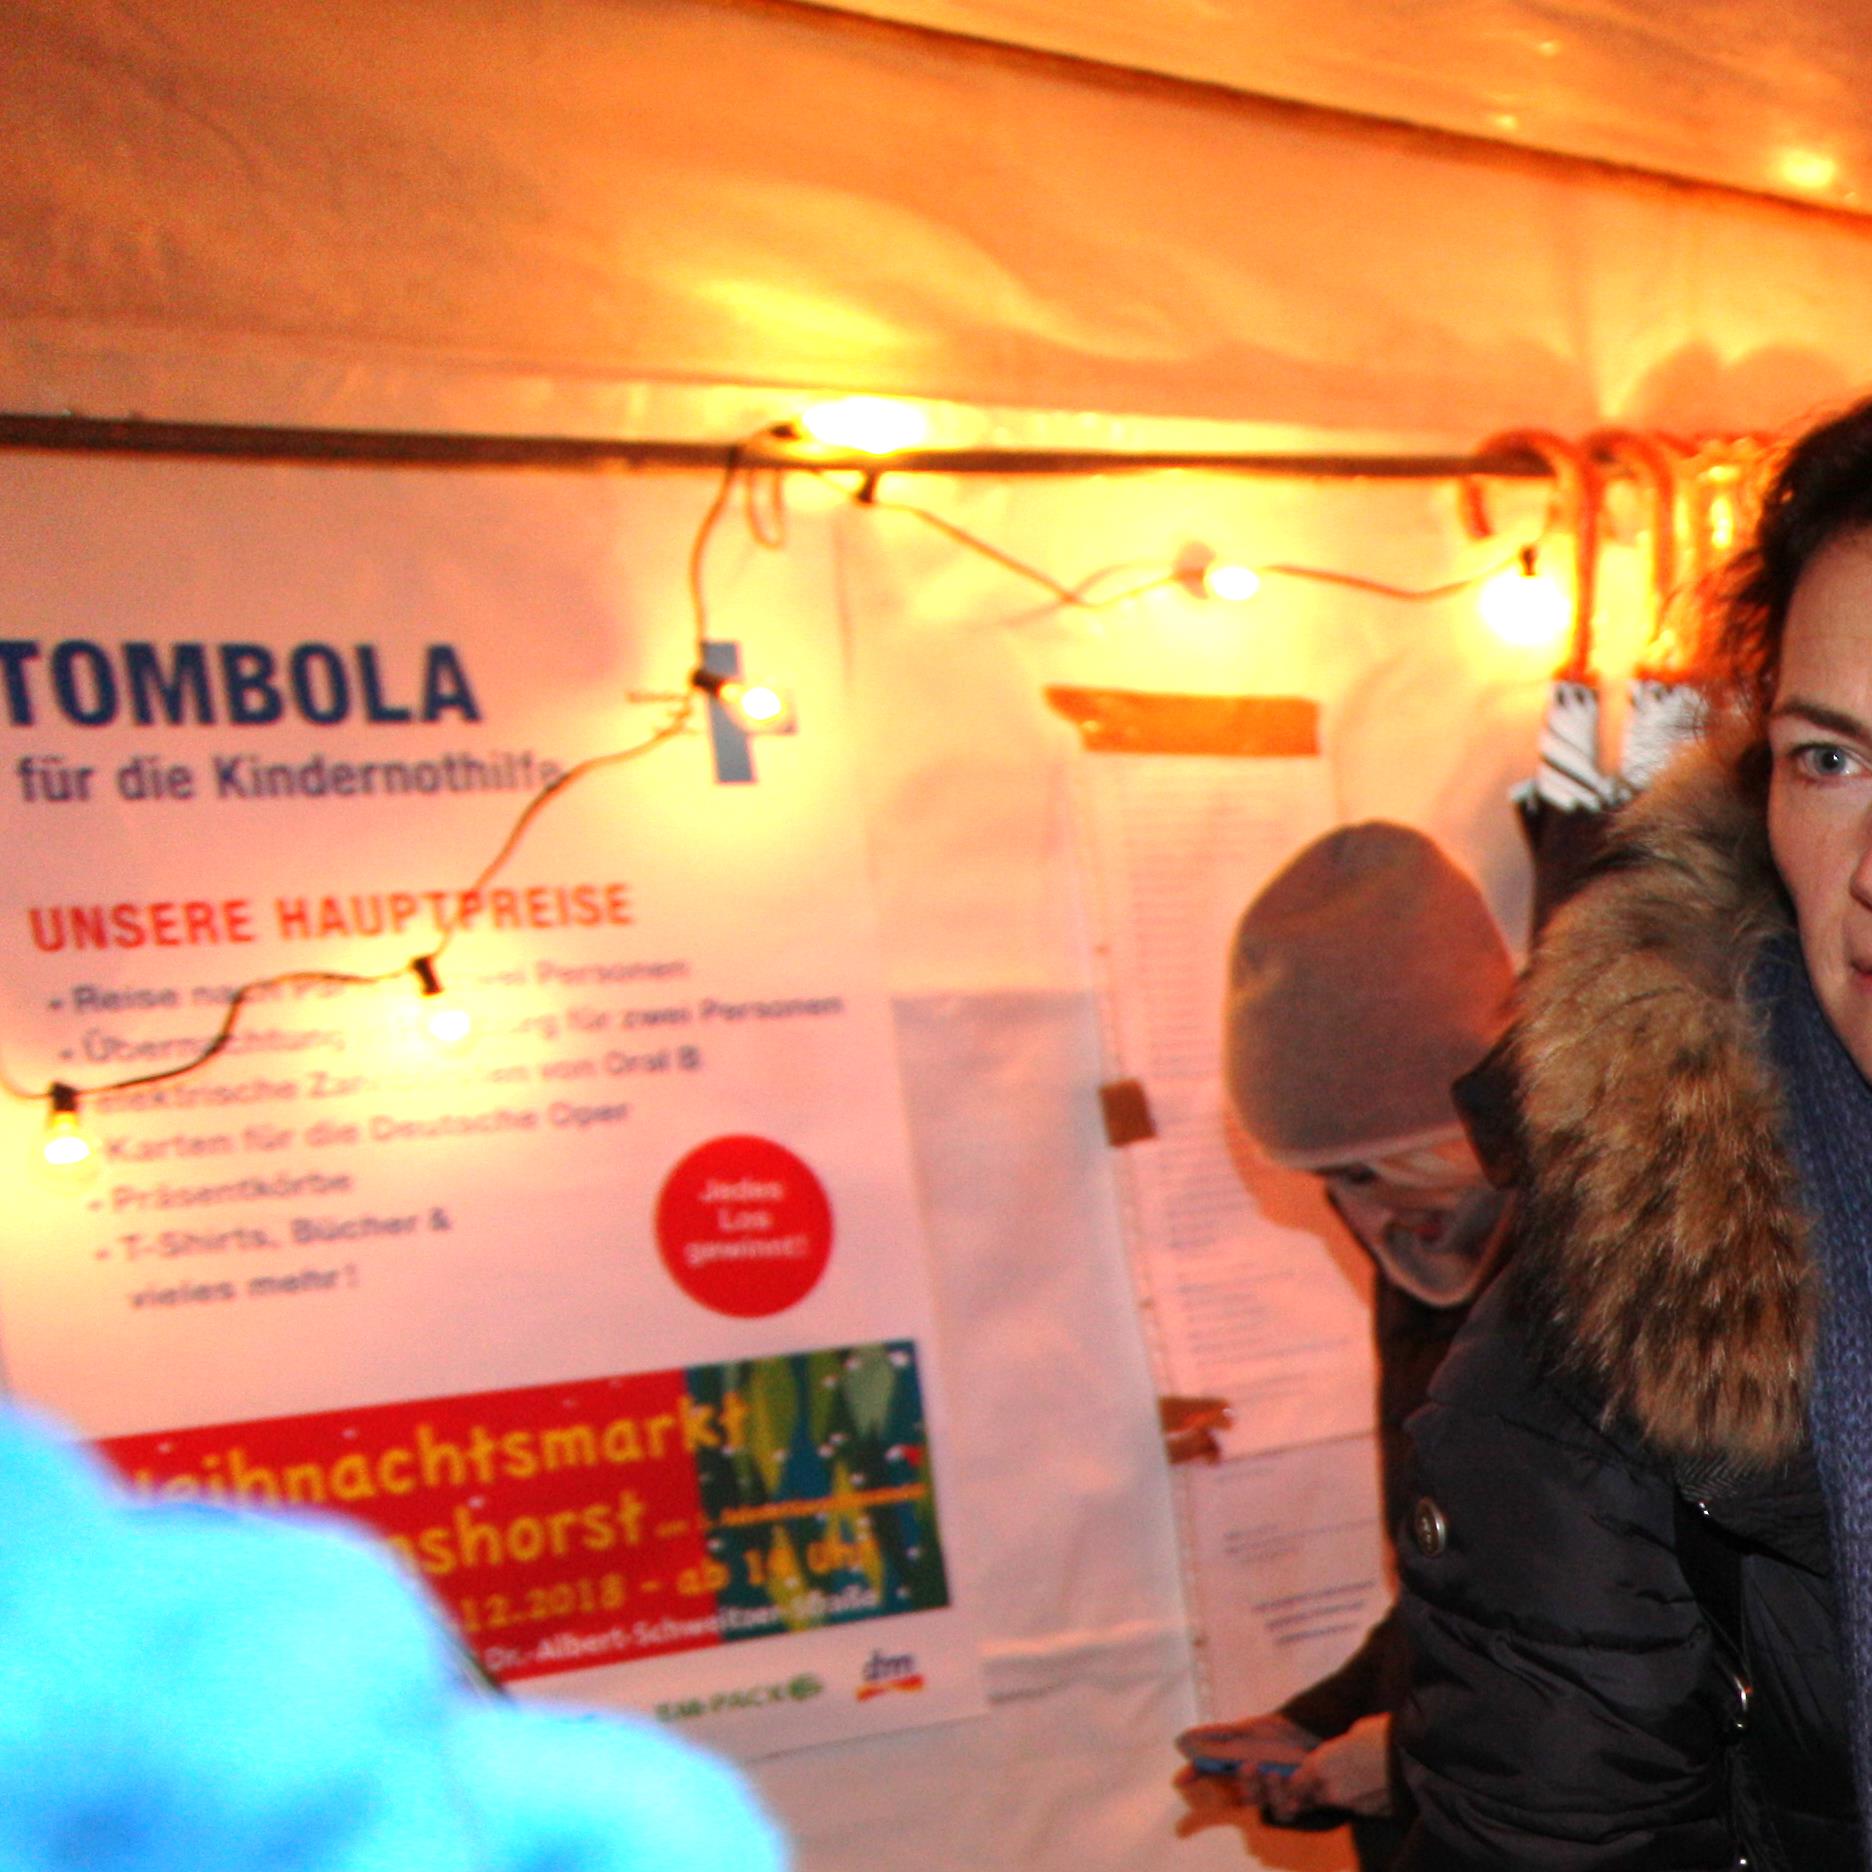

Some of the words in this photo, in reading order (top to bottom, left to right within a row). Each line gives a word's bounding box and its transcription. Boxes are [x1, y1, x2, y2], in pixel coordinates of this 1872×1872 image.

[0, 640, 482, 726] TOMBOLA
[17, 755, 91, 802] für
[116, 753, 195, 800] die
[211, 750, 563, 799] Kindernothilfe
[28, 900, 257, 953] UNSERE
[276, 883, 635, 940] HAUPTPREISE
[700, 997, 843, 1022] Personen
[700, 1177, 785, 1203] Jedes
[717, 1208, 772, 1232] Los
[398, 1492, 646, 1577] shorst
